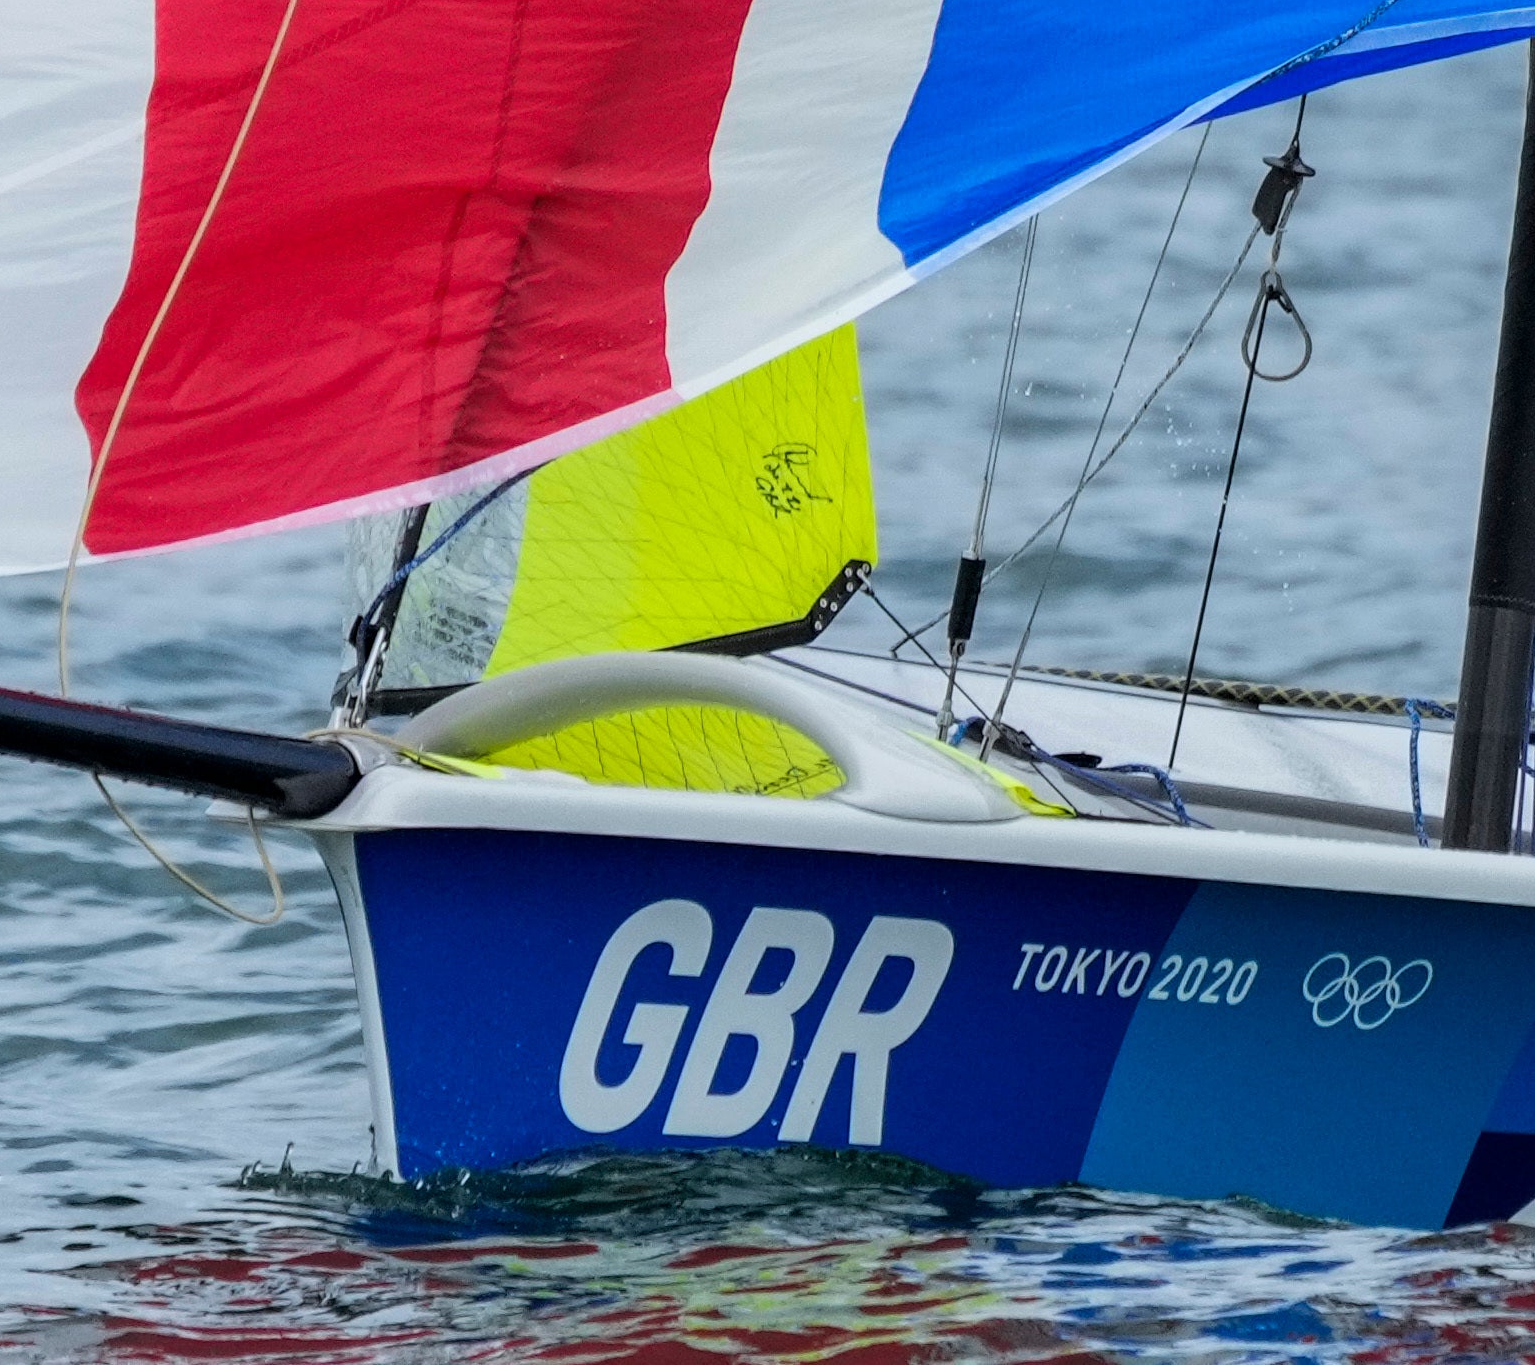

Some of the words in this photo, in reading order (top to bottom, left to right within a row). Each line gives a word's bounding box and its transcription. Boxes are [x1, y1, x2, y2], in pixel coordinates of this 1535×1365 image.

[558, 898, 955, 1147] GBR
[1012, 942, 1151, 999] TOKYO
[1147, 954, 1259, 1006] 2020
